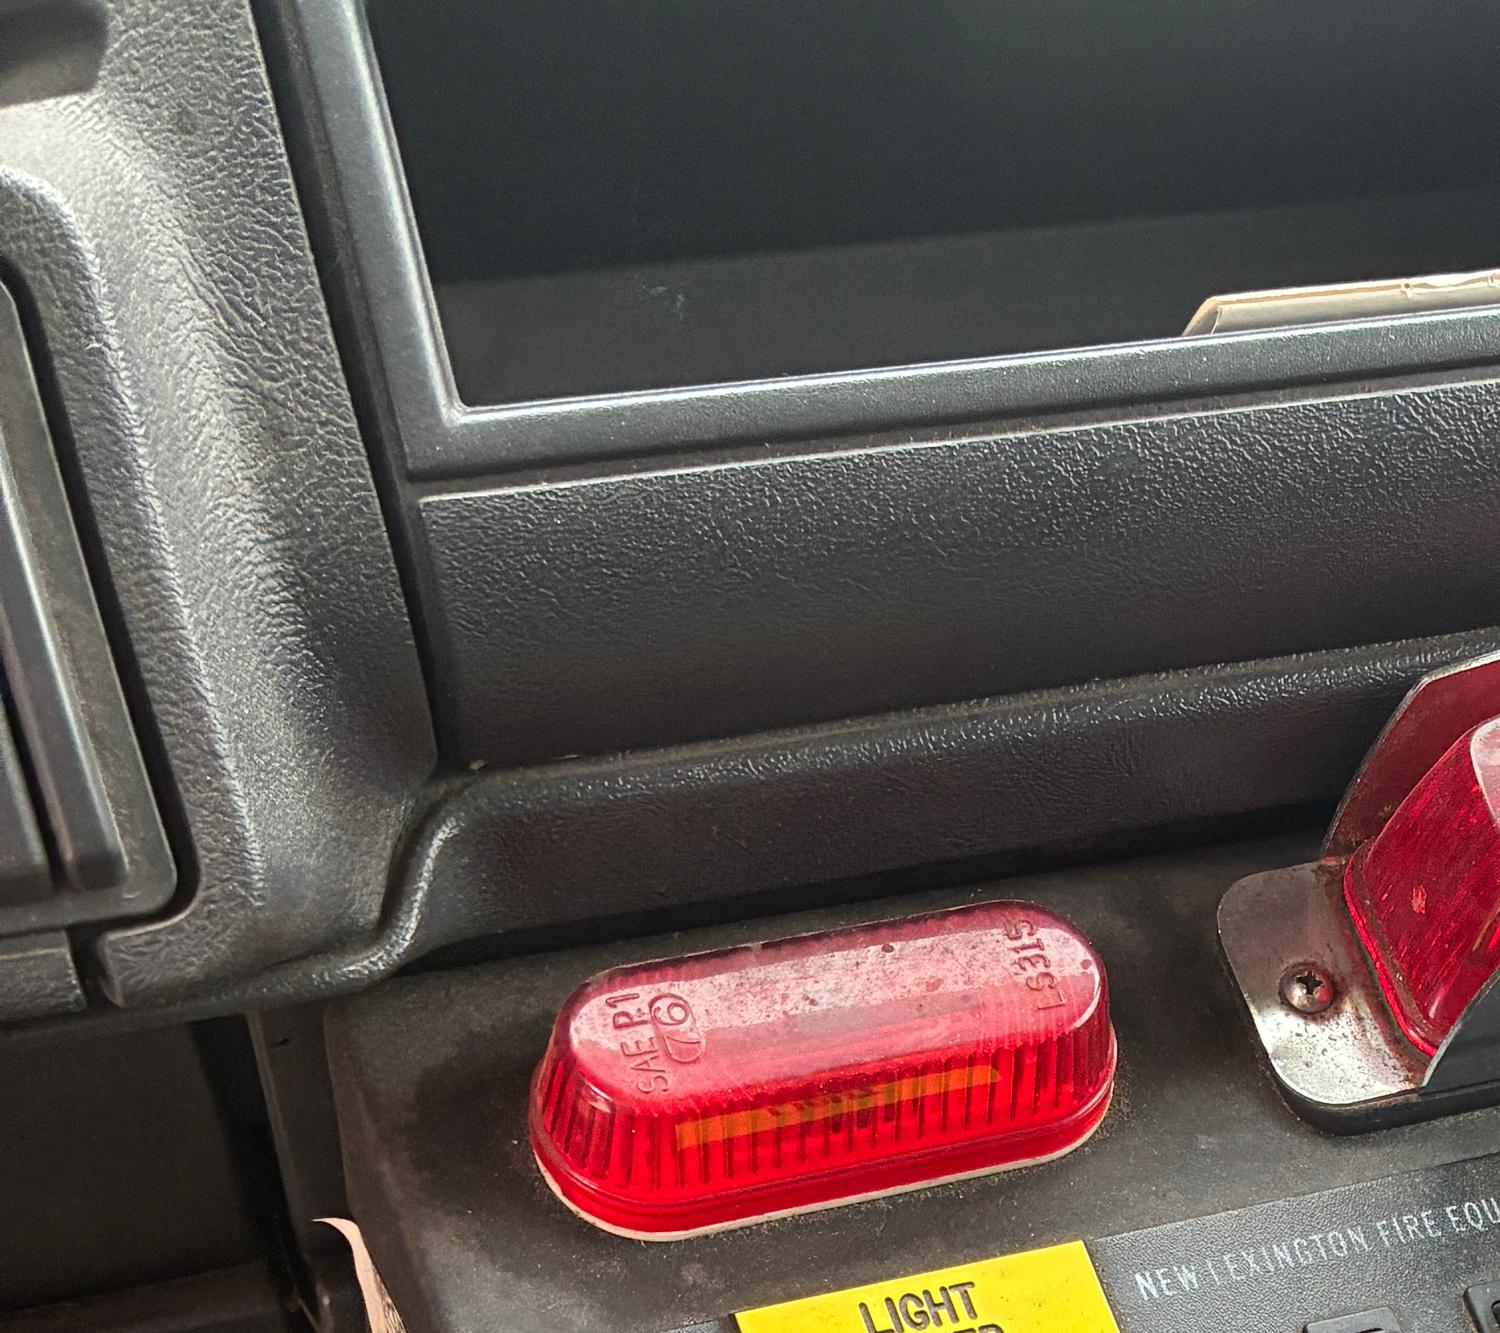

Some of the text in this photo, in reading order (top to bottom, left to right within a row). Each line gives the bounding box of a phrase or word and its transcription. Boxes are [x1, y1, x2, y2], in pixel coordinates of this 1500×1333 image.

[620, 1036, 670, 1095] SAE
[1134, 1264, 1200, 1300] NEW
[1206, 1226, 1375, 1286] LEXINGTON
[1375, 1209, 1443, 1248] FIRE
